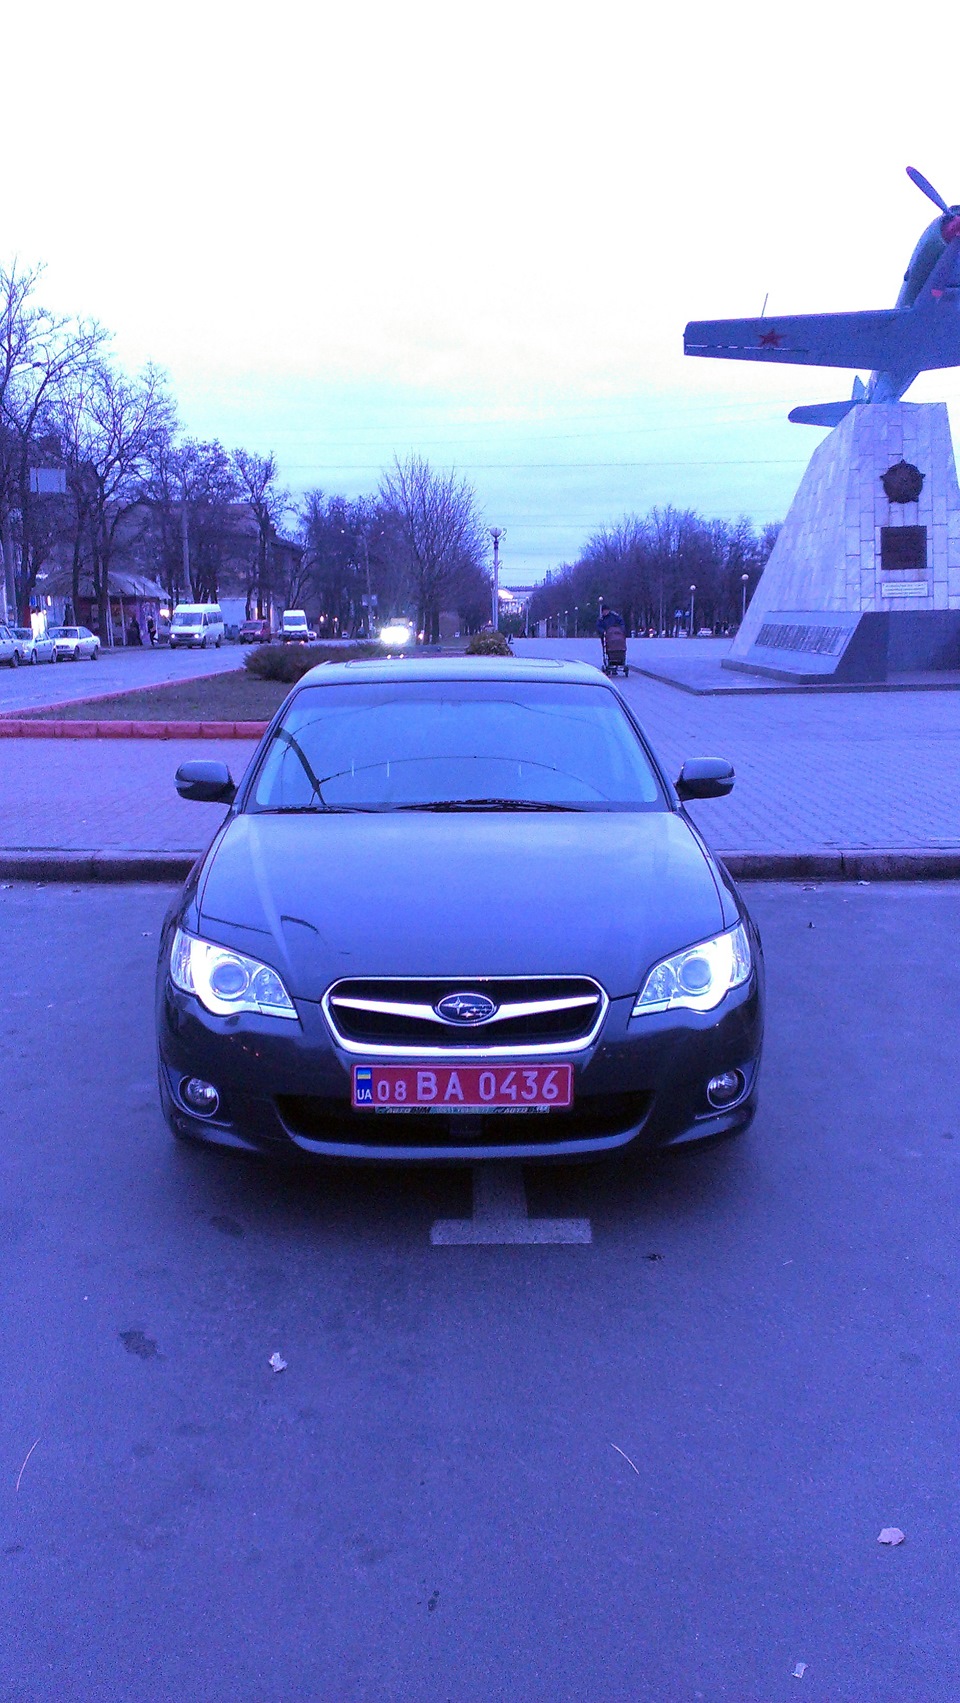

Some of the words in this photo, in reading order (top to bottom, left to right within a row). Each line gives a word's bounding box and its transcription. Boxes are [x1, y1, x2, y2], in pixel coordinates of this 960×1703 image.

[357, 1089, 373, 1100] UA
[377, 1080, 407, 1101] 08
[416, 1071, 464, 1101] BA
[479, 1070, 559, 1101] 0436
